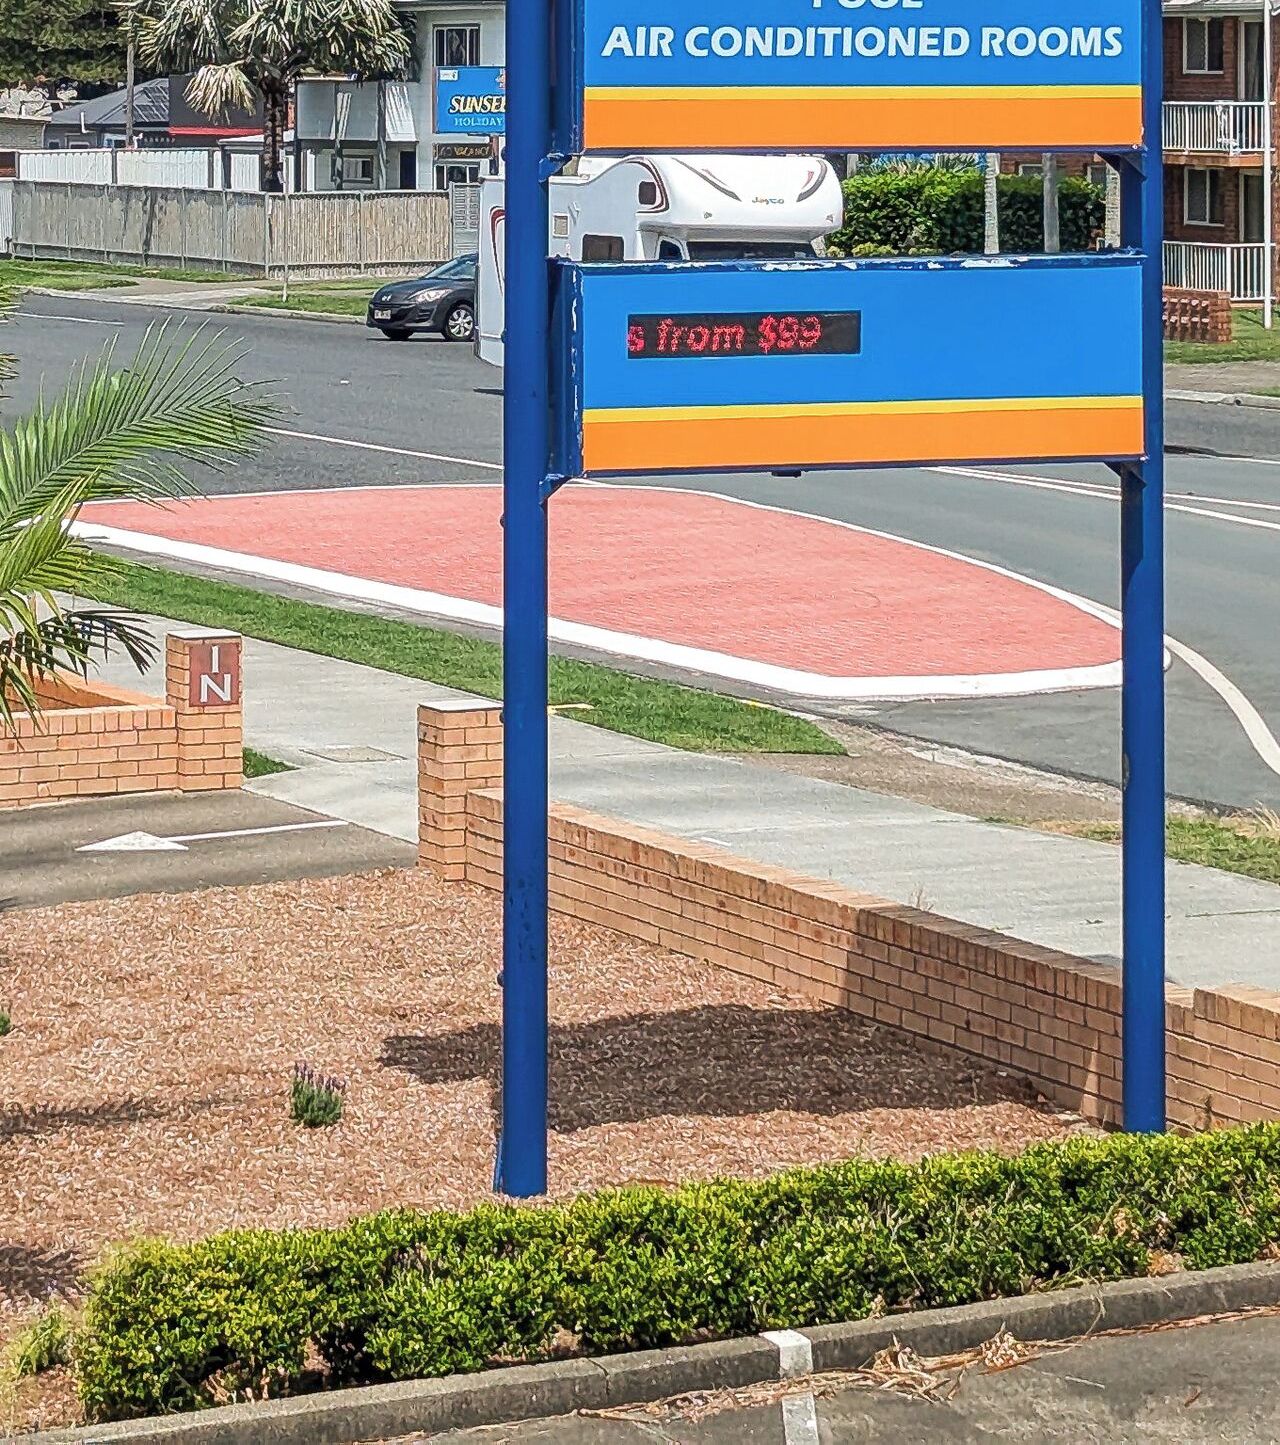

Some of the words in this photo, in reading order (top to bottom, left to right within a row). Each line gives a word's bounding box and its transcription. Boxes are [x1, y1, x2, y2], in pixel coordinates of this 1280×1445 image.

[601, 26, 674, 57] AIR
[685, 26, 971, 57] CONDITIONED
[979, 26, 1123, 57] ROOMS
[454, 117, 503, 126] HOLIDAY
[657, 318, 744, 351] from
[758, 315, 821, 354] $99
